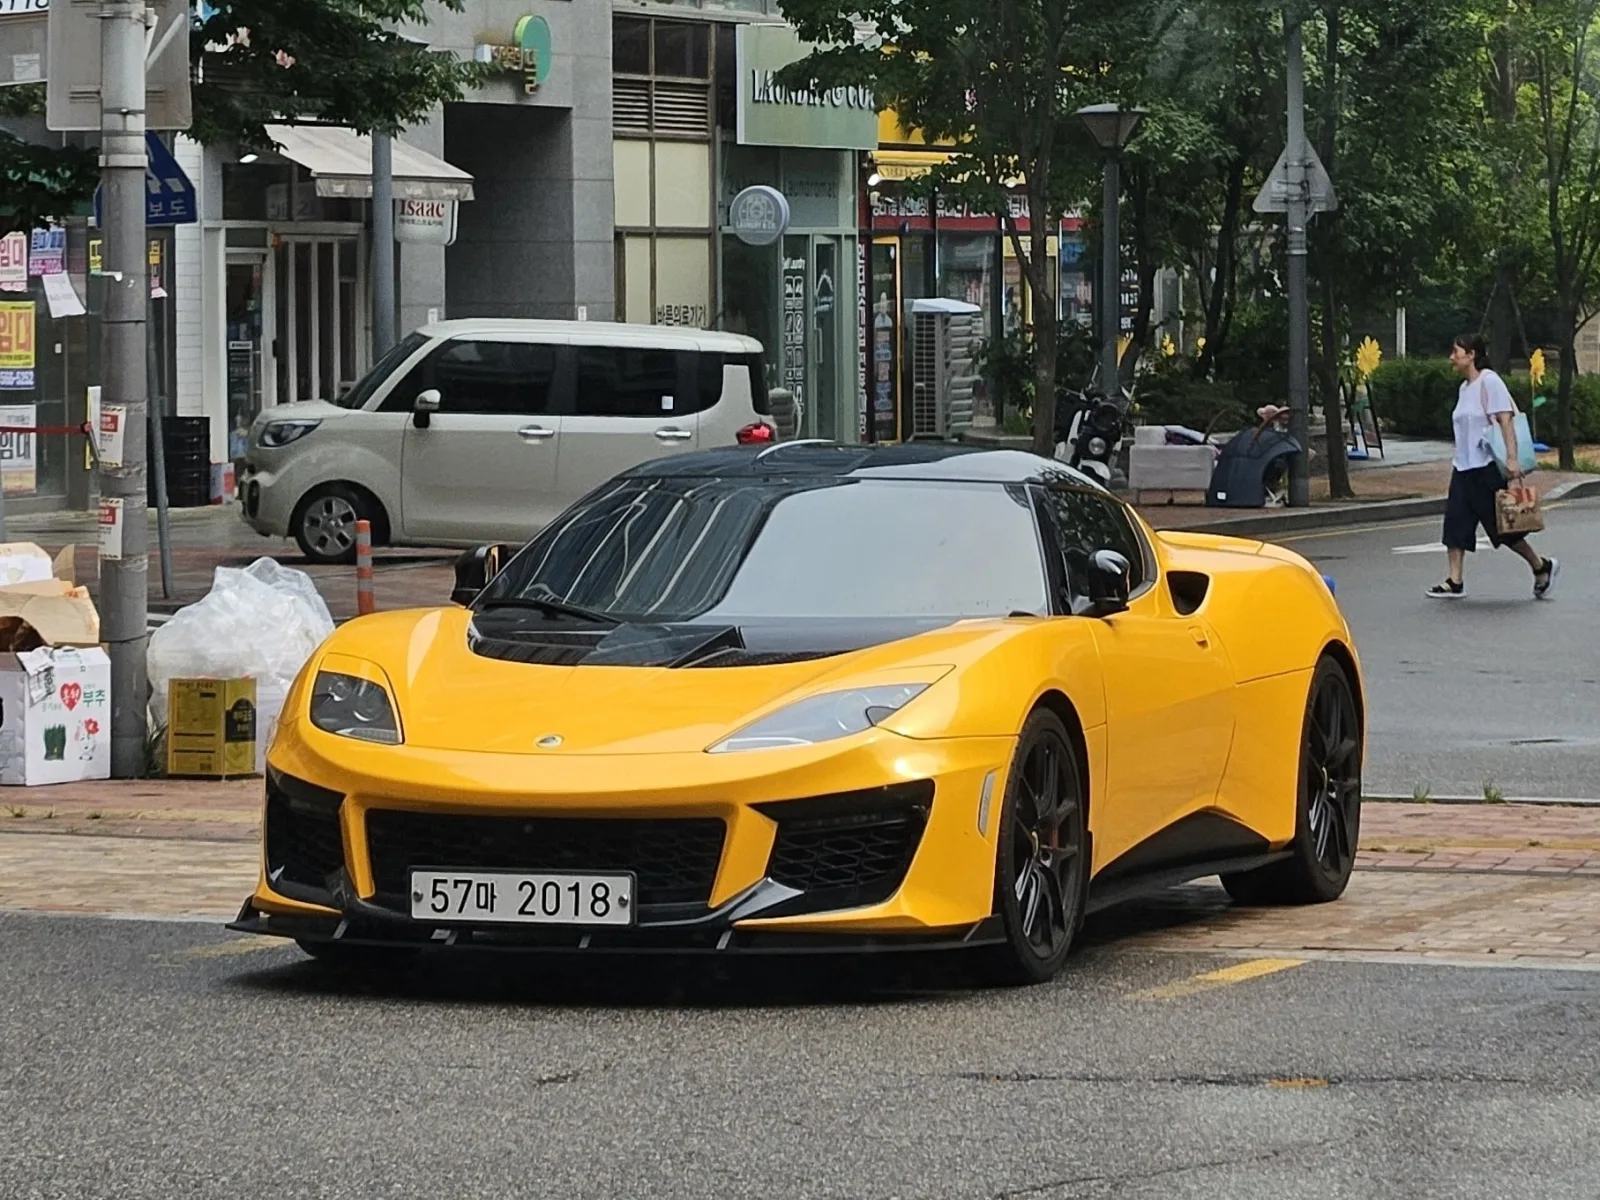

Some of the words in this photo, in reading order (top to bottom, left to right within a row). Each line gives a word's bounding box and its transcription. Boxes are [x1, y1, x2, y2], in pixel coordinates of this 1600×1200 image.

[148, 199, 187, 218] 보도
[400, 199, 445, 218] Isaac
[83, 689, 105, 708] 부추
[430, 879, 497, 914] 57마
[517, 880, 611, 917] 2018
